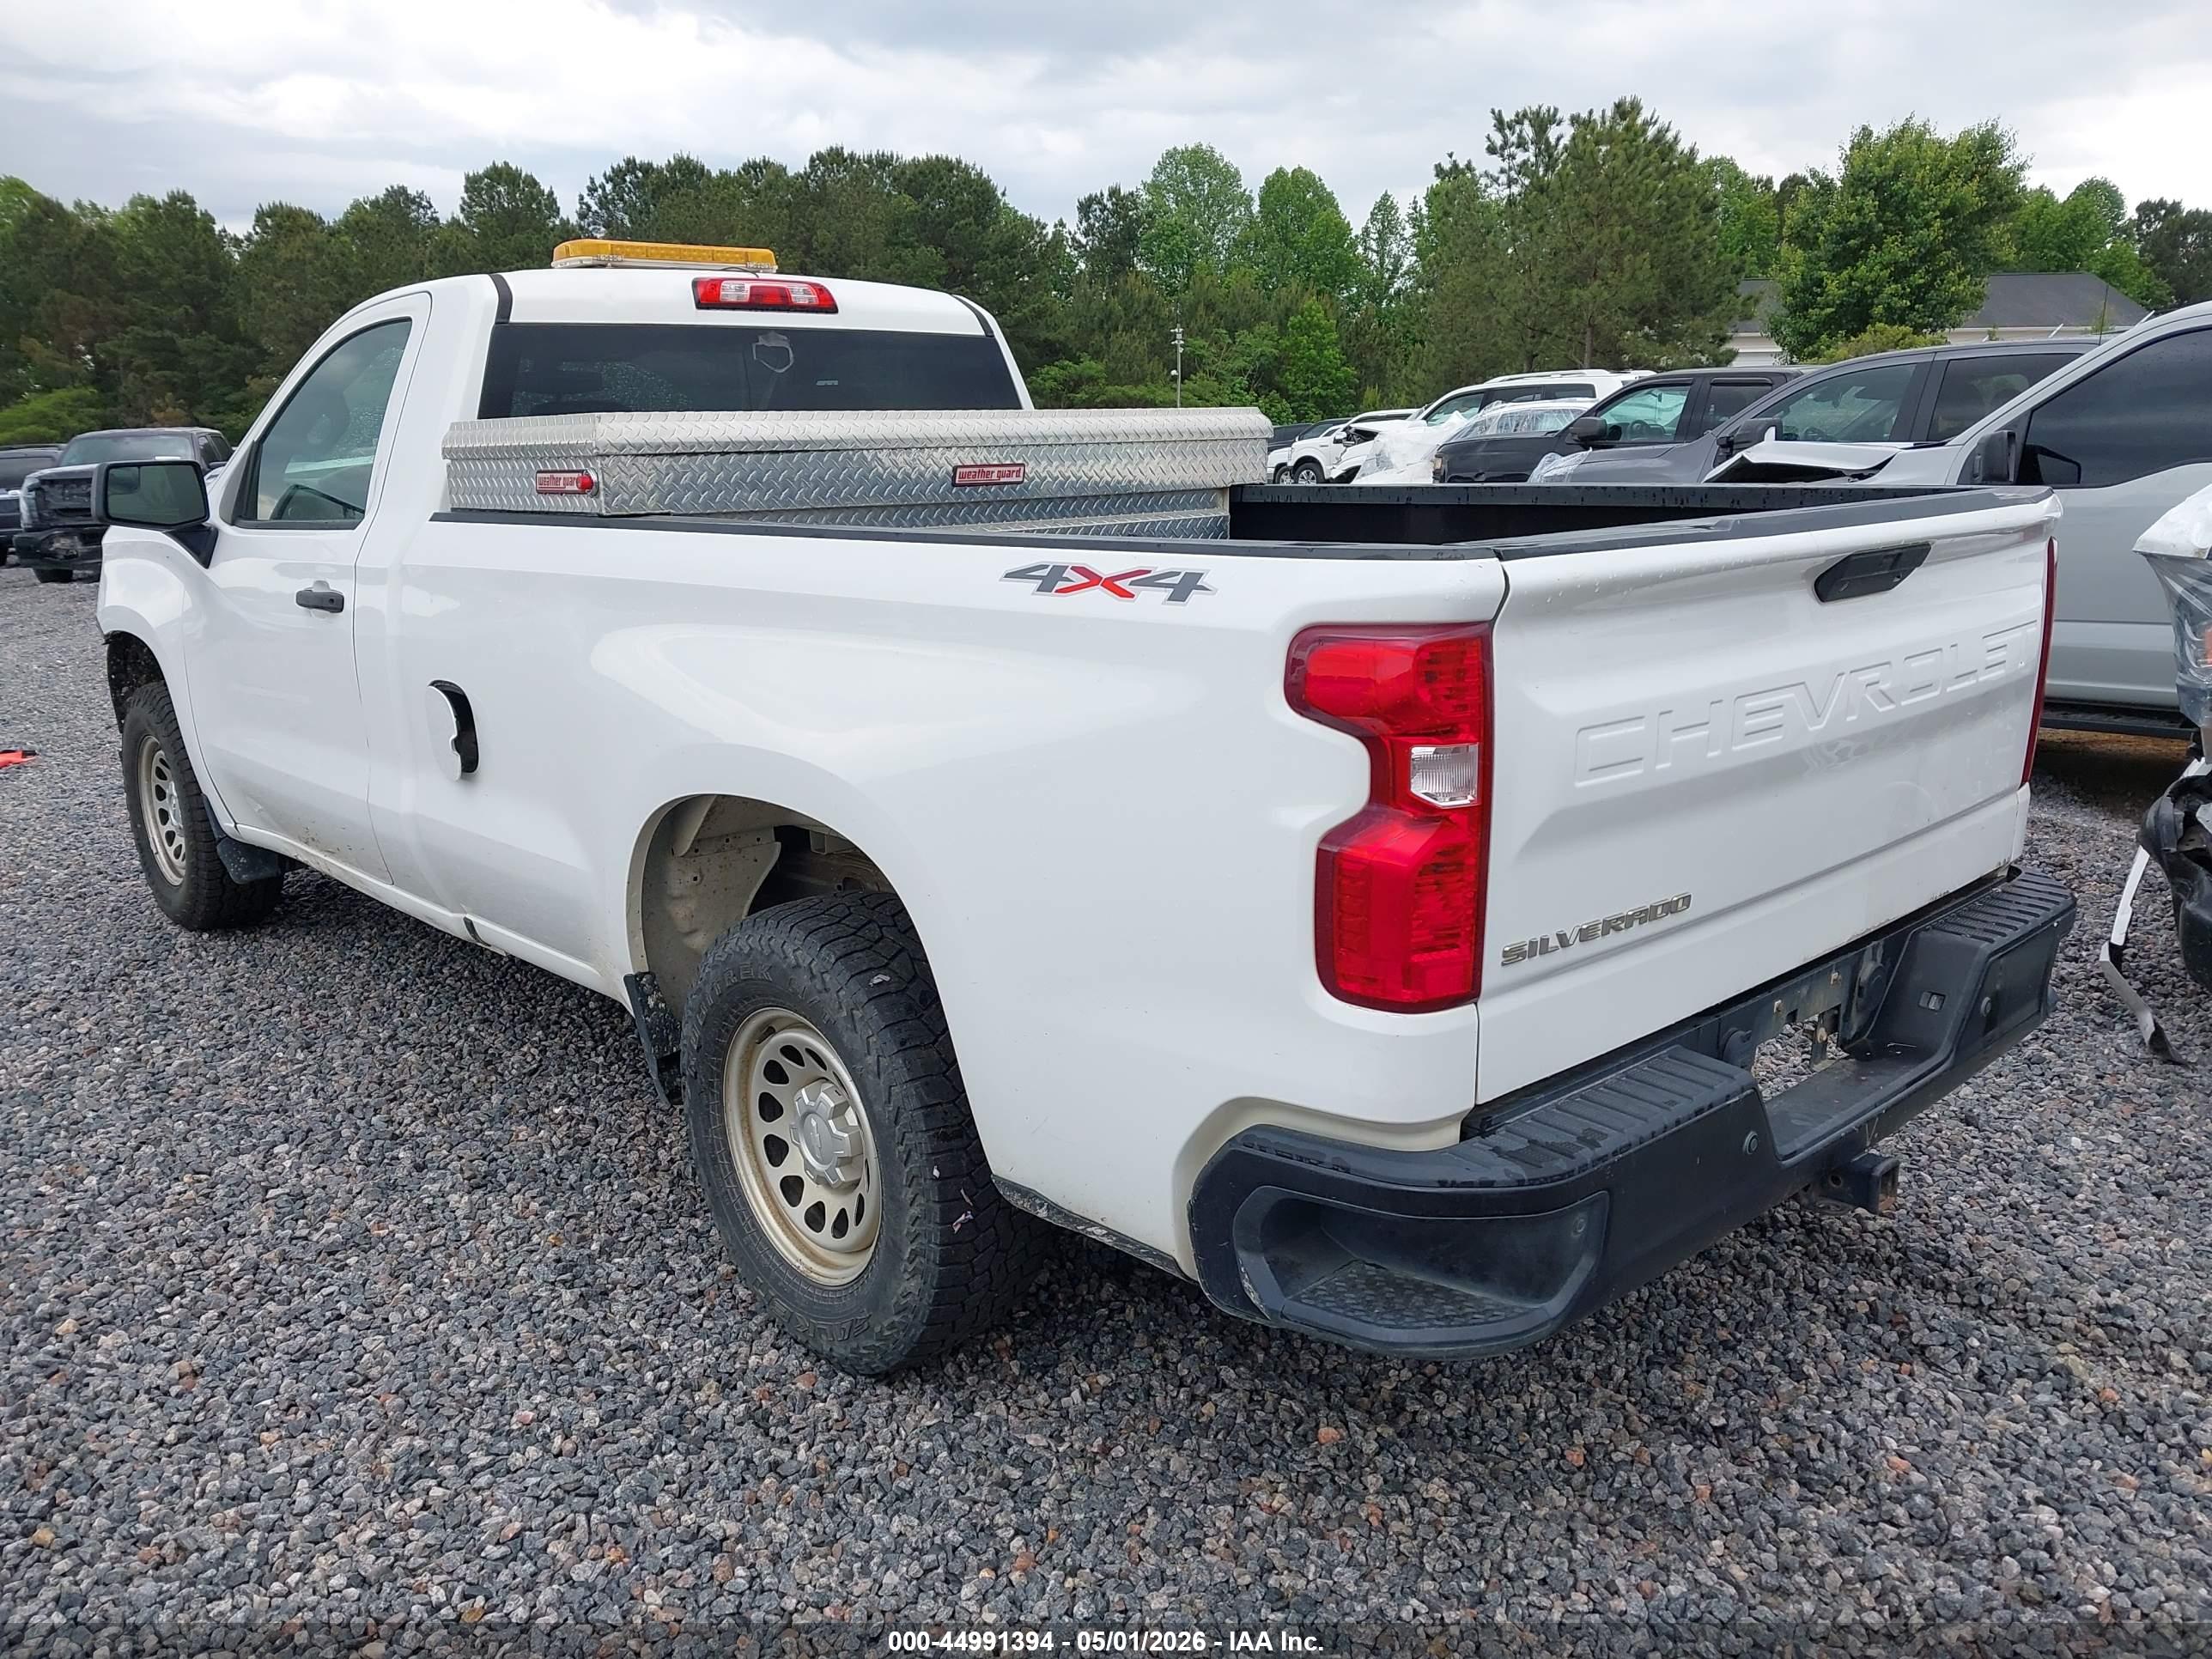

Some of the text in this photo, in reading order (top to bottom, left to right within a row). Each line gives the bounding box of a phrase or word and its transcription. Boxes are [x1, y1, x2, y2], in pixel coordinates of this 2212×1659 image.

[538, 474, 562, 487] weather
[958, 467, 1021, 481] weather guard
[1575, 619, 2038, 787] CHEVROLET
[1501, 892, 1692, 967] SILVERADO
